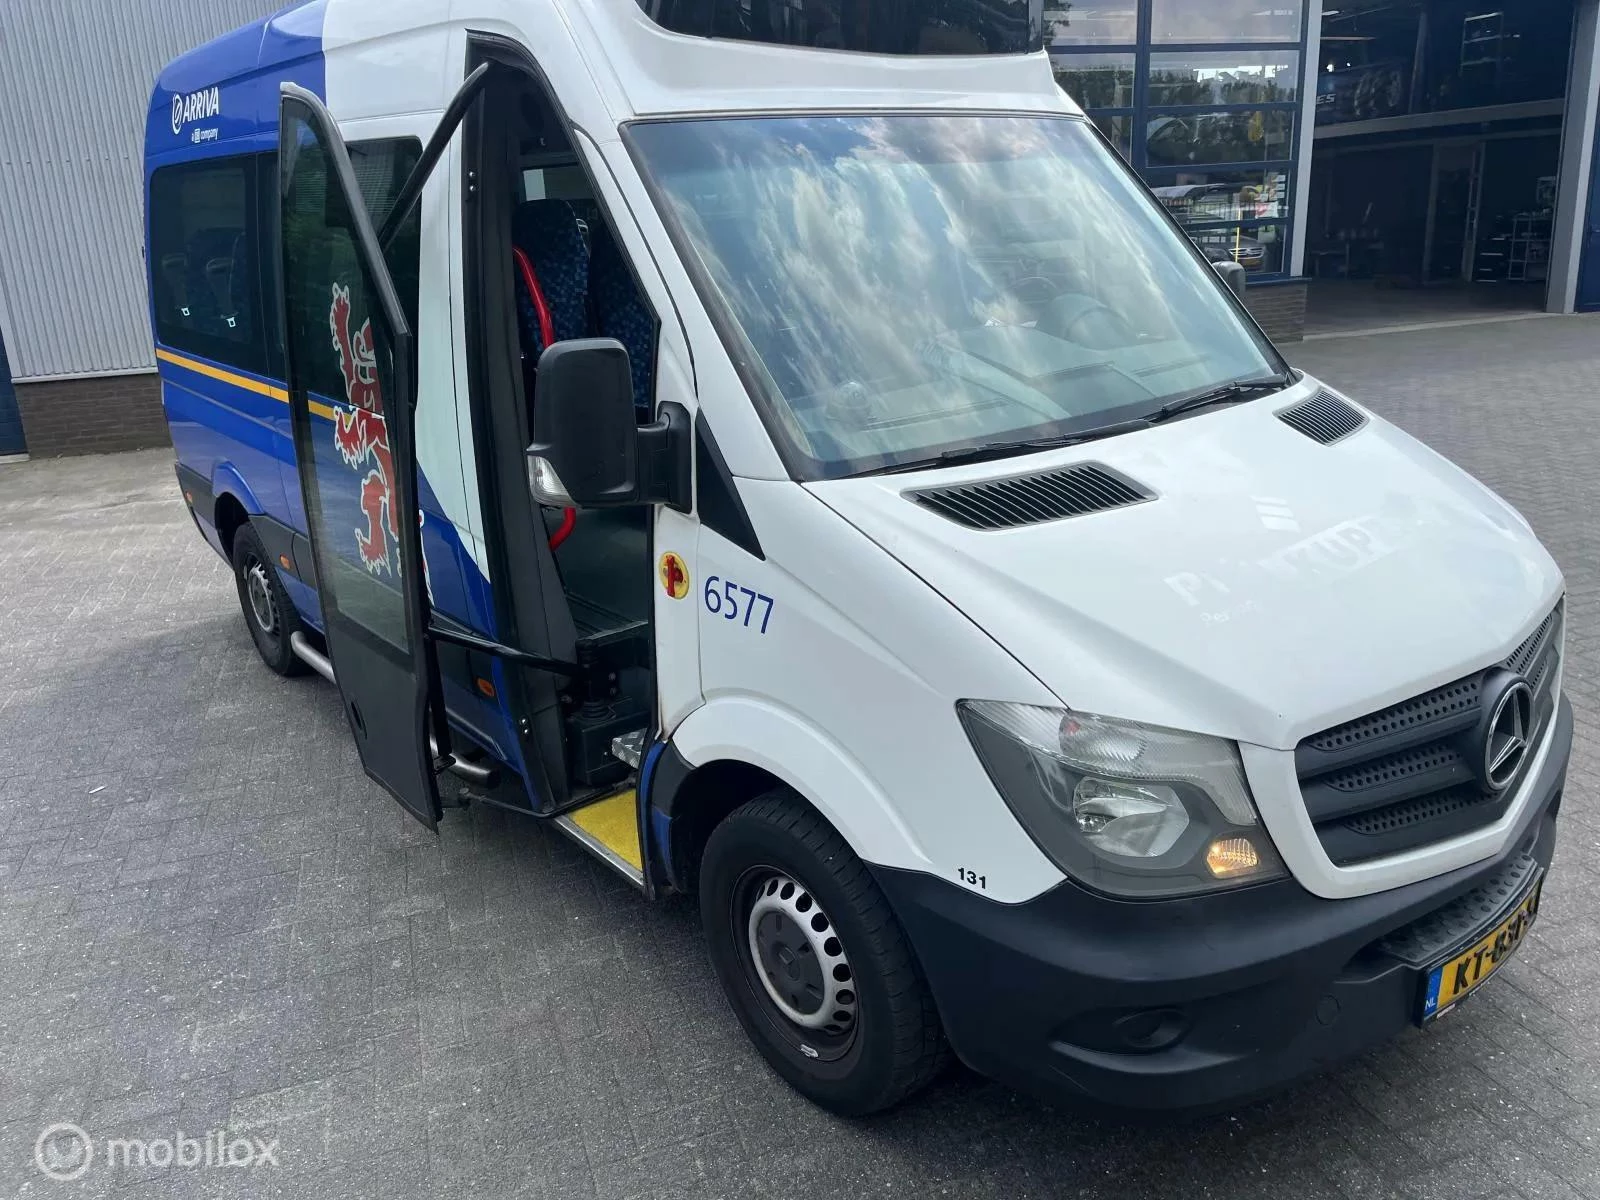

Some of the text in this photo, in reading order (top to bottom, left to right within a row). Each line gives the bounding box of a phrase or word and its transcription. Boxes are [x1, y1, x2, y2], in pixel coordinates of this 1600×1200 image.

[182, 86, 220, 124] ARRIVA
[704, 575, 774, 634] 6577
[957, 867, 986, 890] 131
[1424, 998, 1437, 1010] NL
